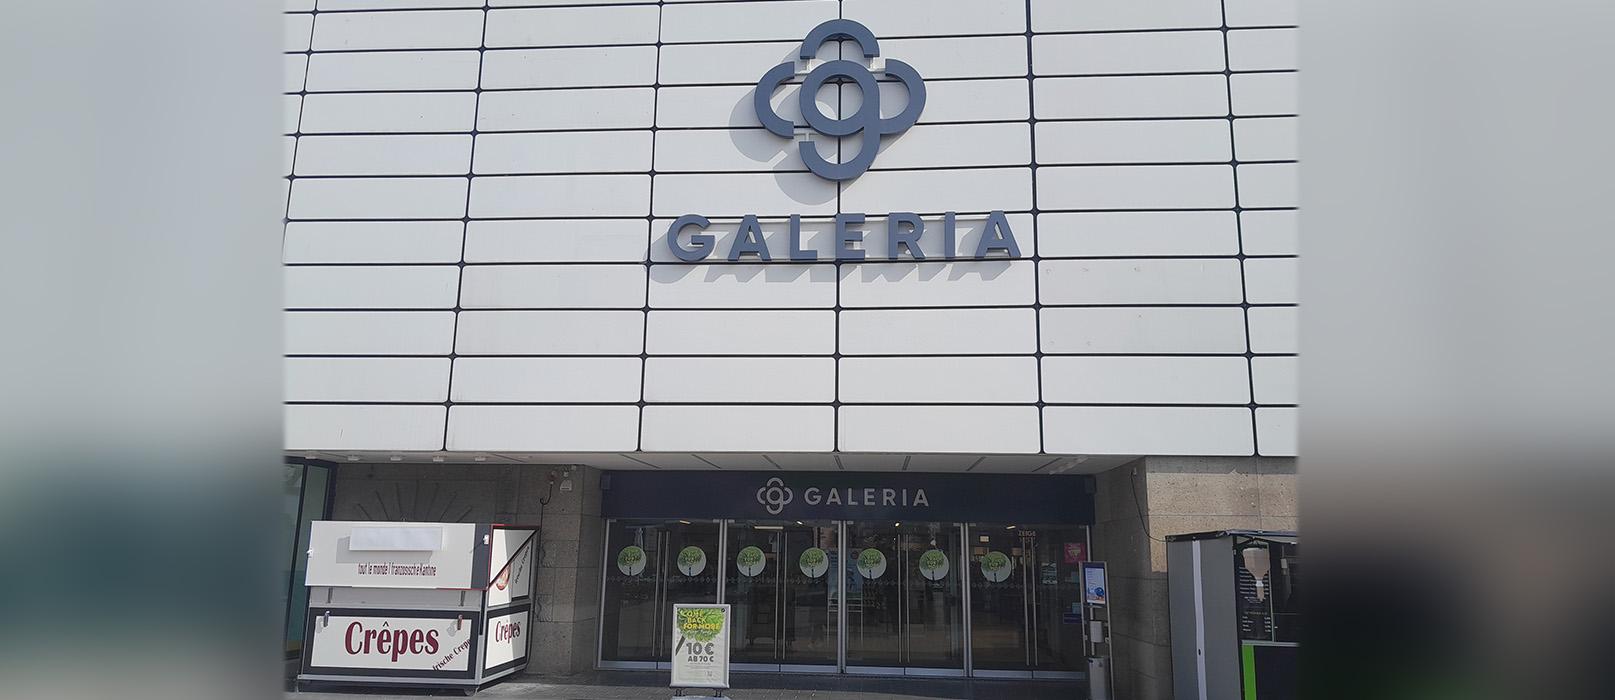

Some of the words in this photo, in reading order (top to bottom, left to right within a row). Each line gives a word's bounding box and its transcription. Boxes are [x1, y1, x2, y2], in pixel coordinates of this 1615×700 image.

[667, 210, 1022, 262] GALERIA
[804, 487, 929, 506] GALERIA
[358, 562, 367, 575] tout
[368, 562, 373, 575] le
[373, 562, 388, 575] monde
[680, 610, 704, 618] COME
[344, 621, 439, 662] Crêpes
[686, 642, 702, 655] 10
[704, 642, 714, 655] €
